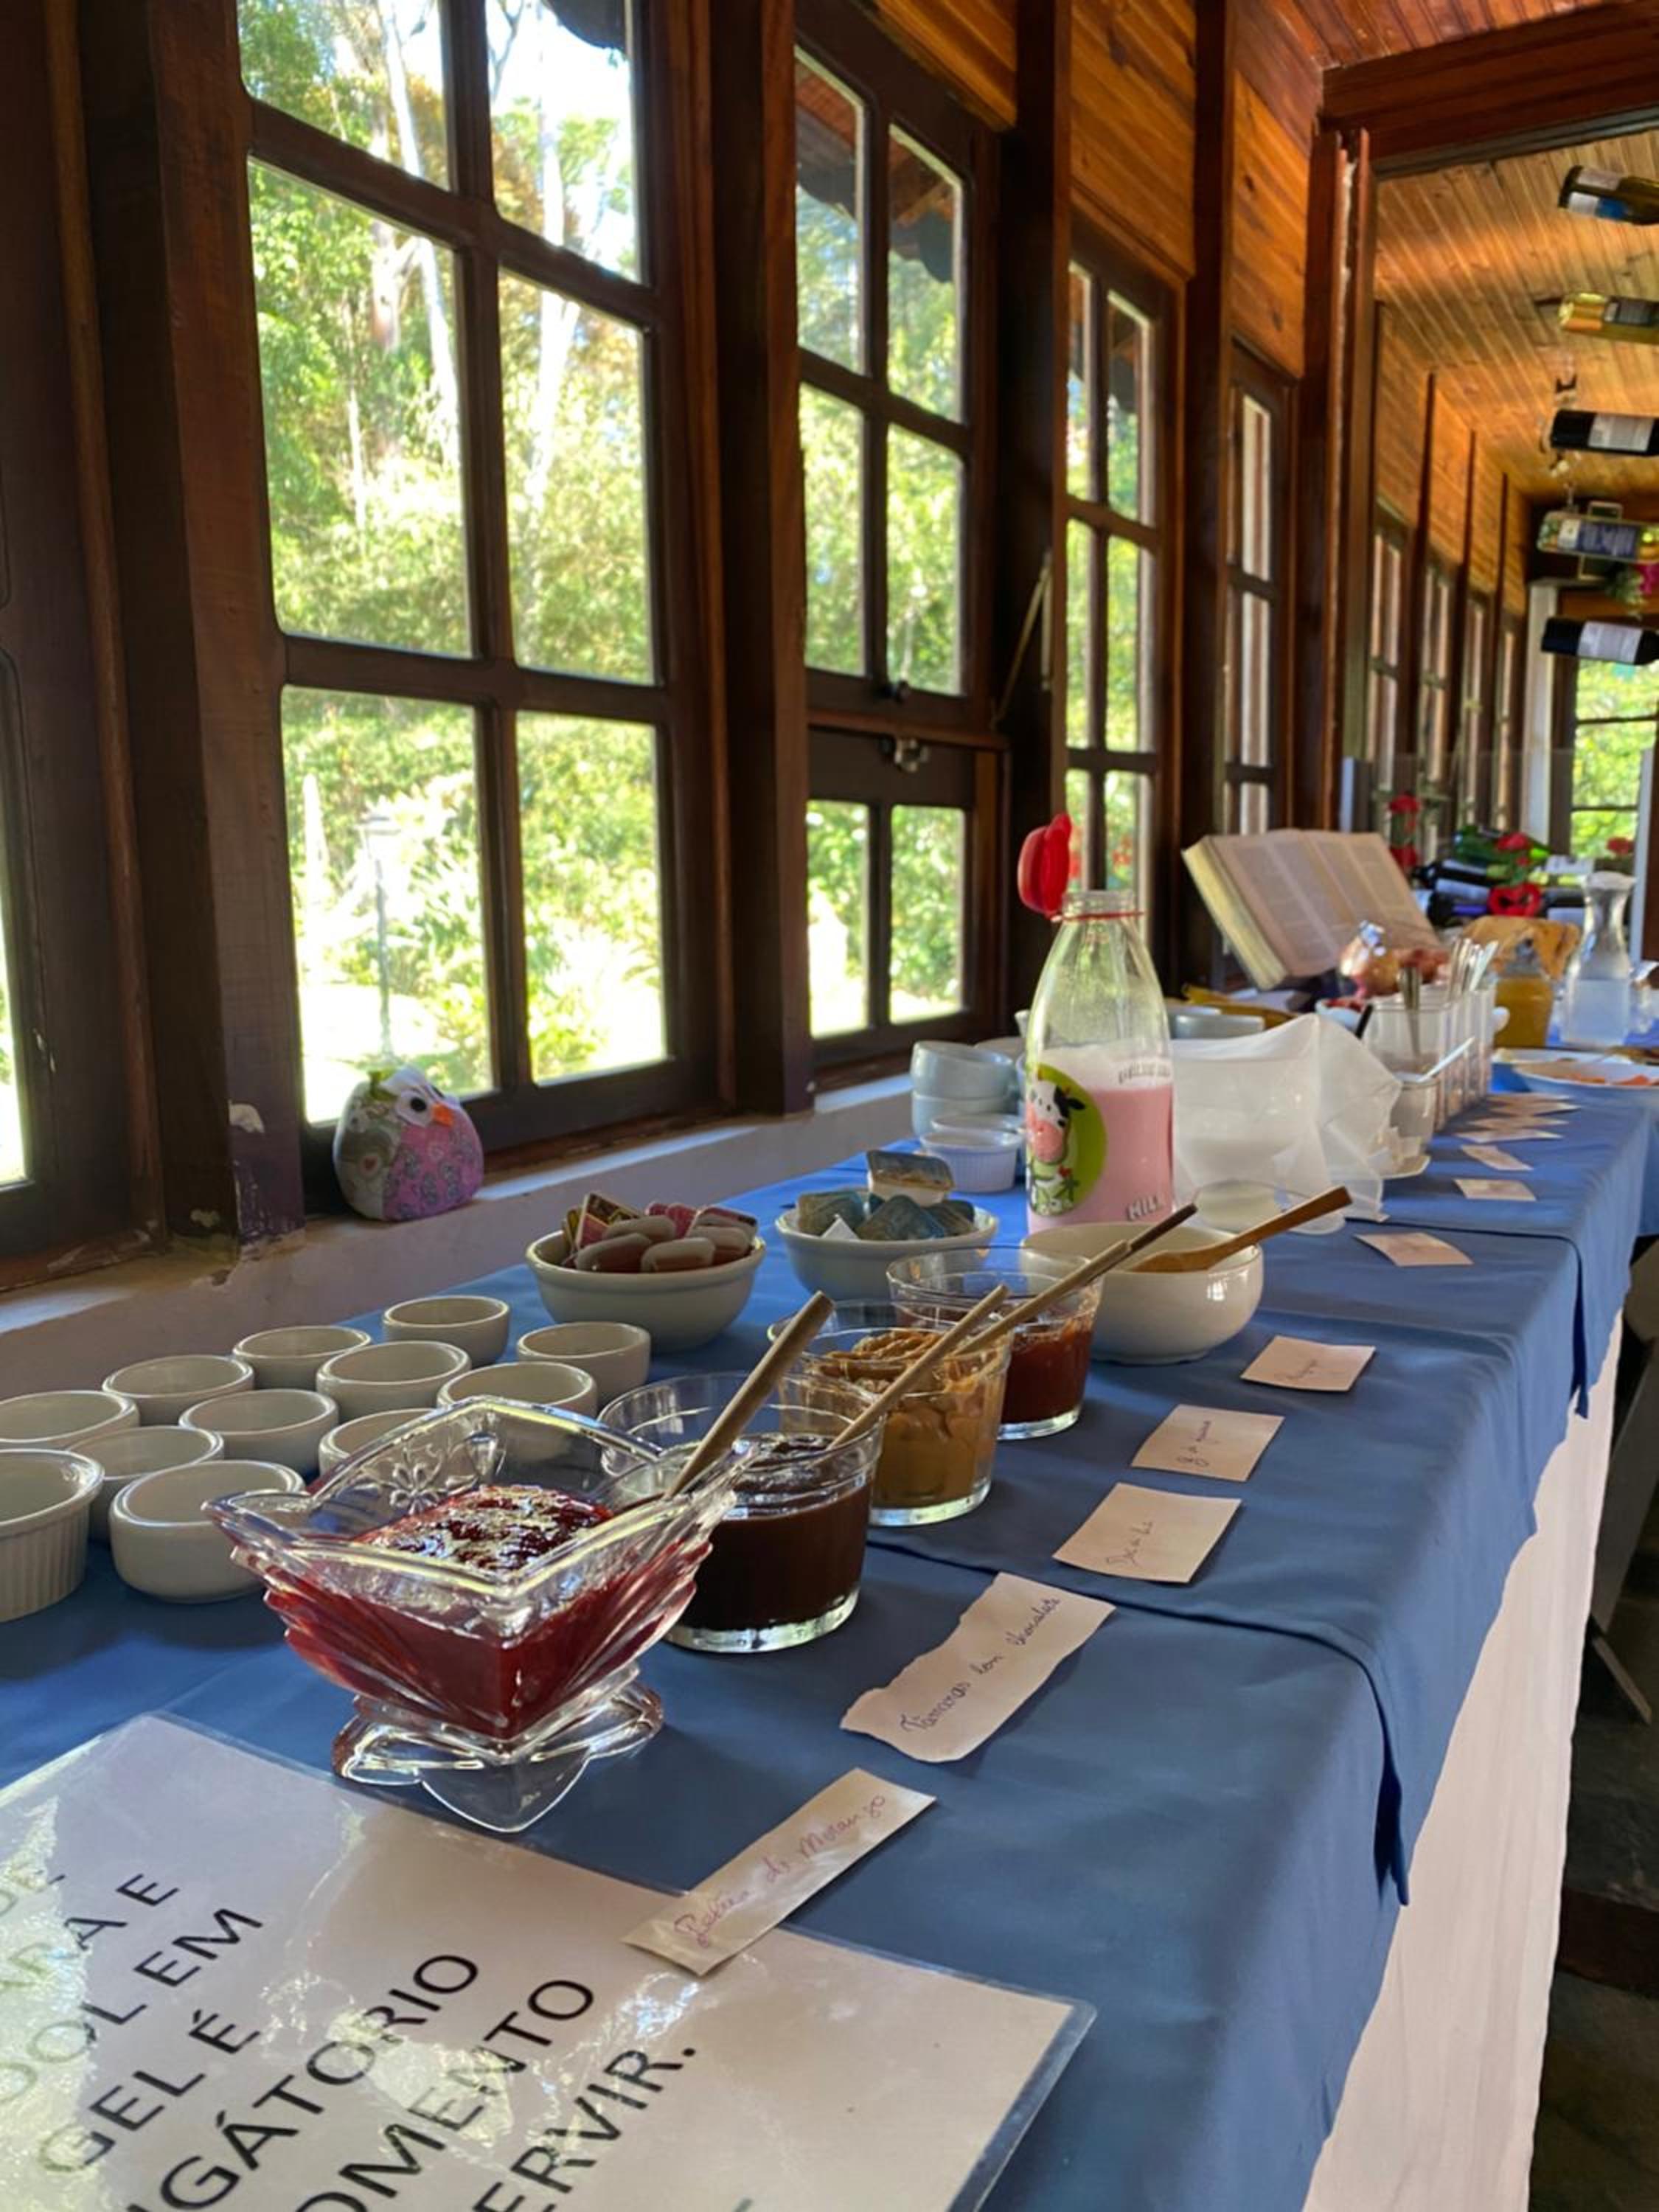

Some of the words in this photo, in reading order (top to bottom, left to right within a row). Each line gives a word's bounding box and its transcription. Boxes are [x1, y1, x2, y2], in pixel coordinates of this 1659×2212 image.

[116, 1874, 179, 1907] E
[133, 1907, 262, 1987] EM
[38, 2069, 206, 2172] GEL
[189, 2008, 260, 2055] É
[127, 1954, 479, 2212] GÁTORIO
